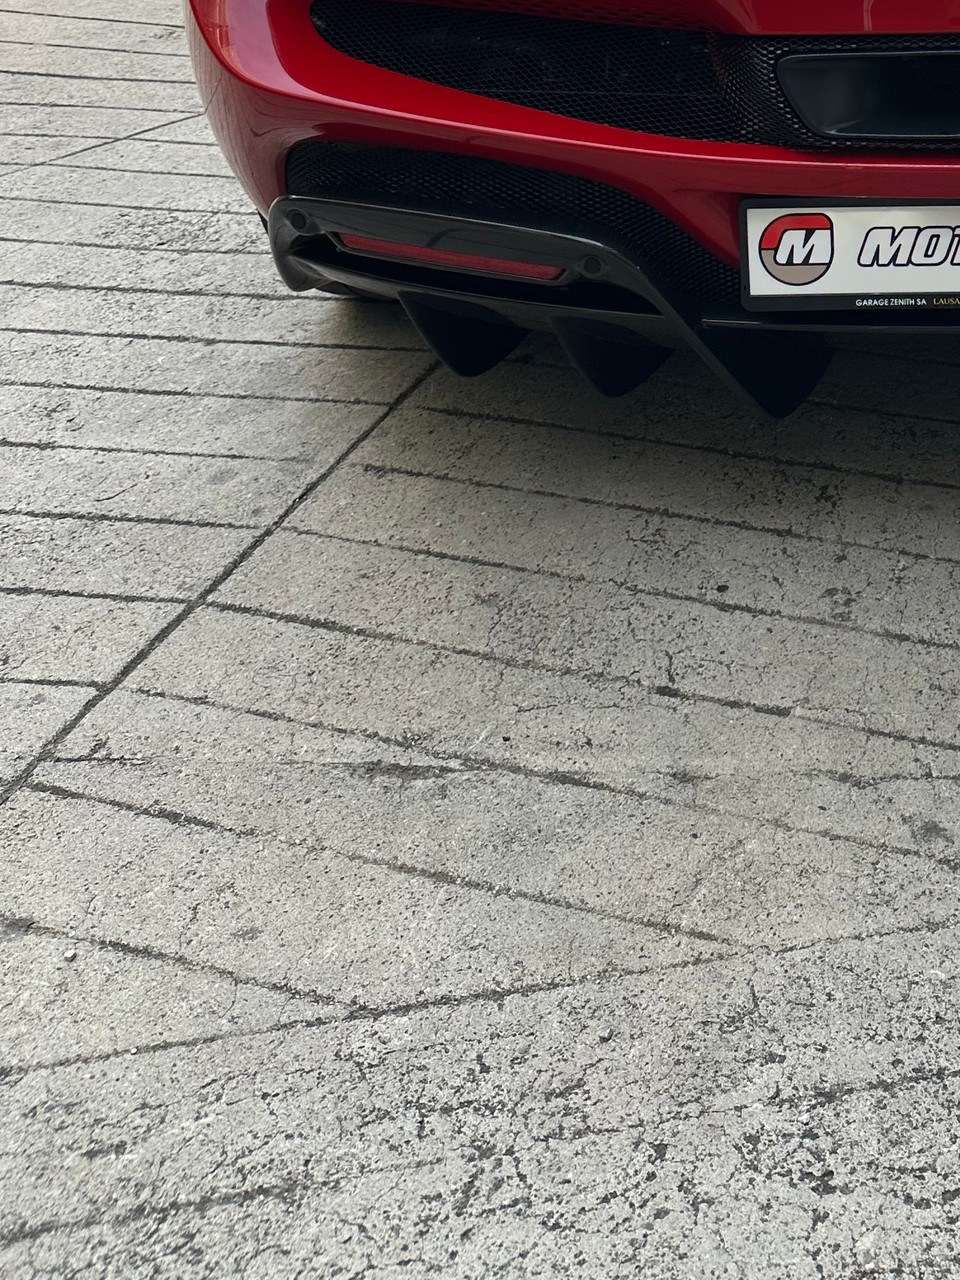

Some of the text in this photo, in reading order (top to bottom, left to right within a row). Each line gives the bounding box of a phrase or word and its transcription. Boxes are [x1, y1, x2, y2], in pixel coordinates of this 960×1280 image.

[855, 298, 889, 307] GARAGE
[890, 297, 915, 306] ZENITH
[916, 297, 927, 305] SA
